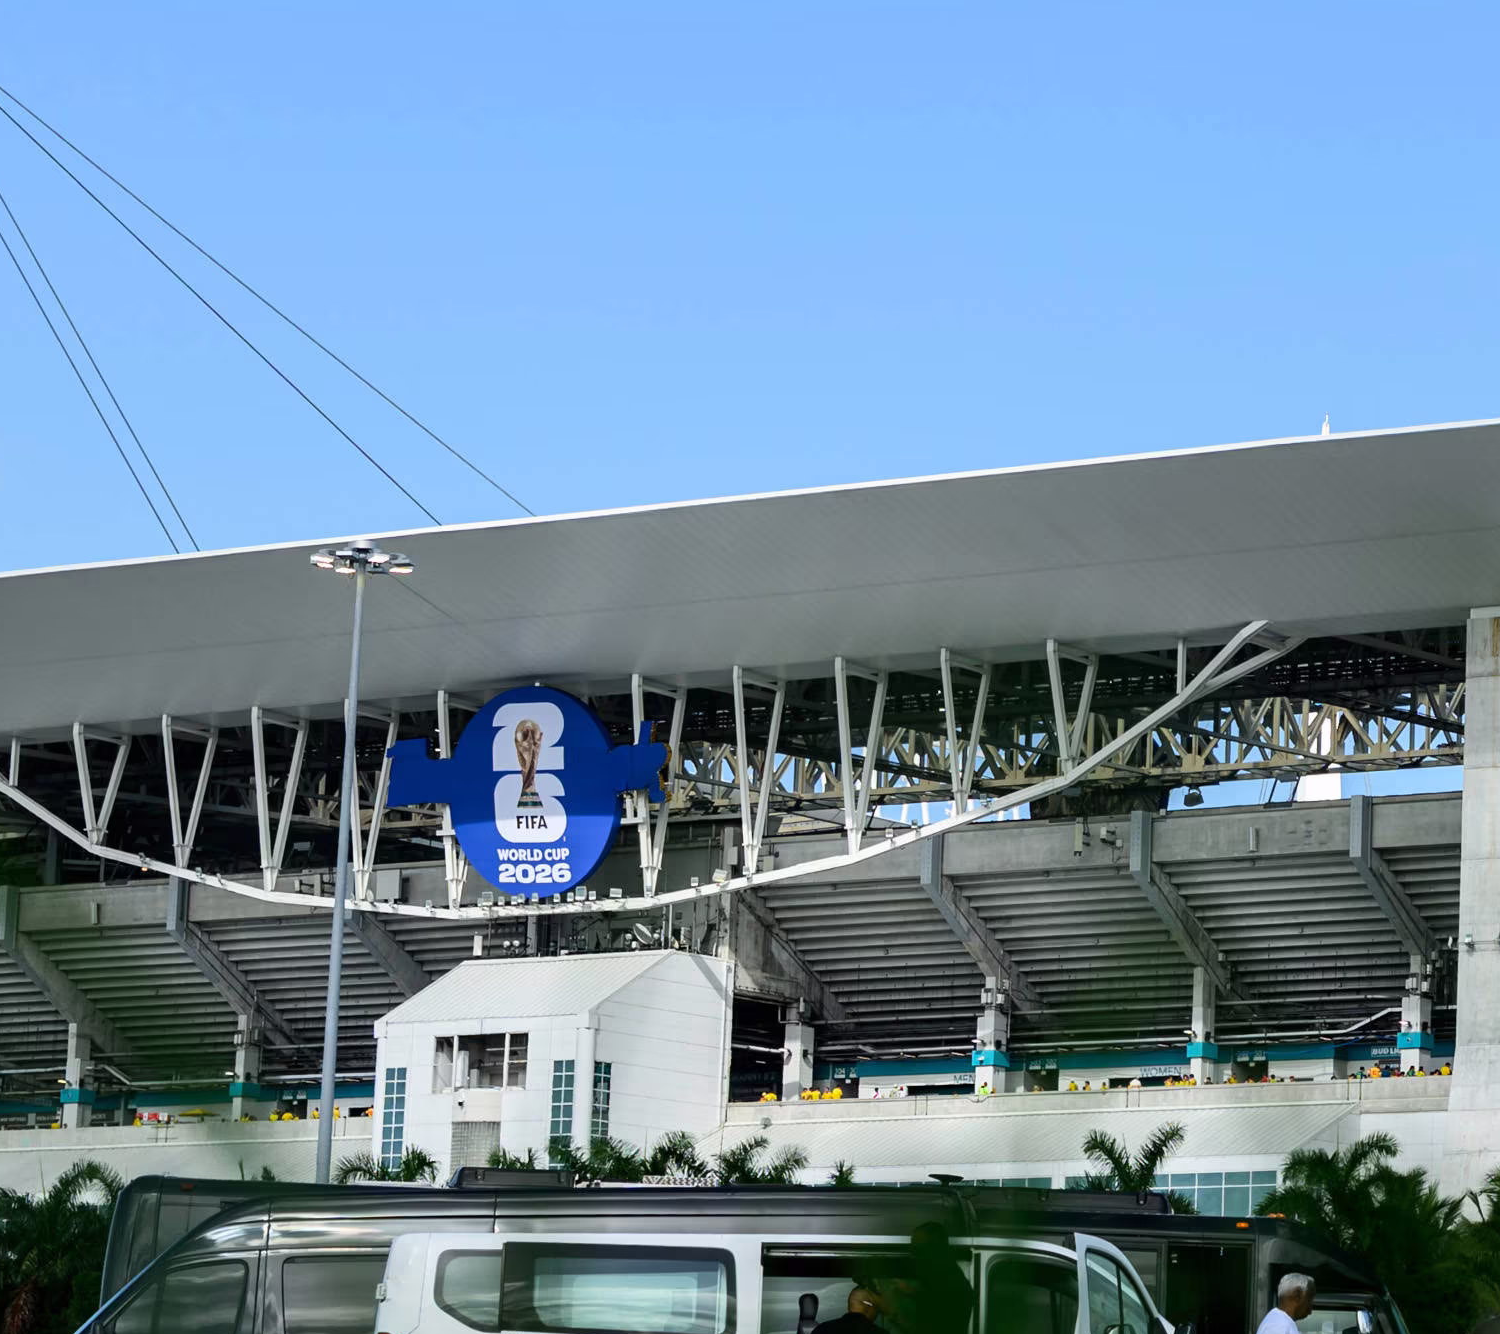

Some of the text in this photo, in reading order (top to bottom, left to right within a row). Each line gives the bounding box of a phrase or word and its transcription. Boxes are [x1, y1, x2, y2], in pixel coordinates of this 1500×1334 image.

[516, 816, 548, 829] FIFA
[497, 848, 570, 861] WORLD CUP
[498, 863, 572, 883] 2026
[1140, 1066, 1182, 1077] WOMEN
